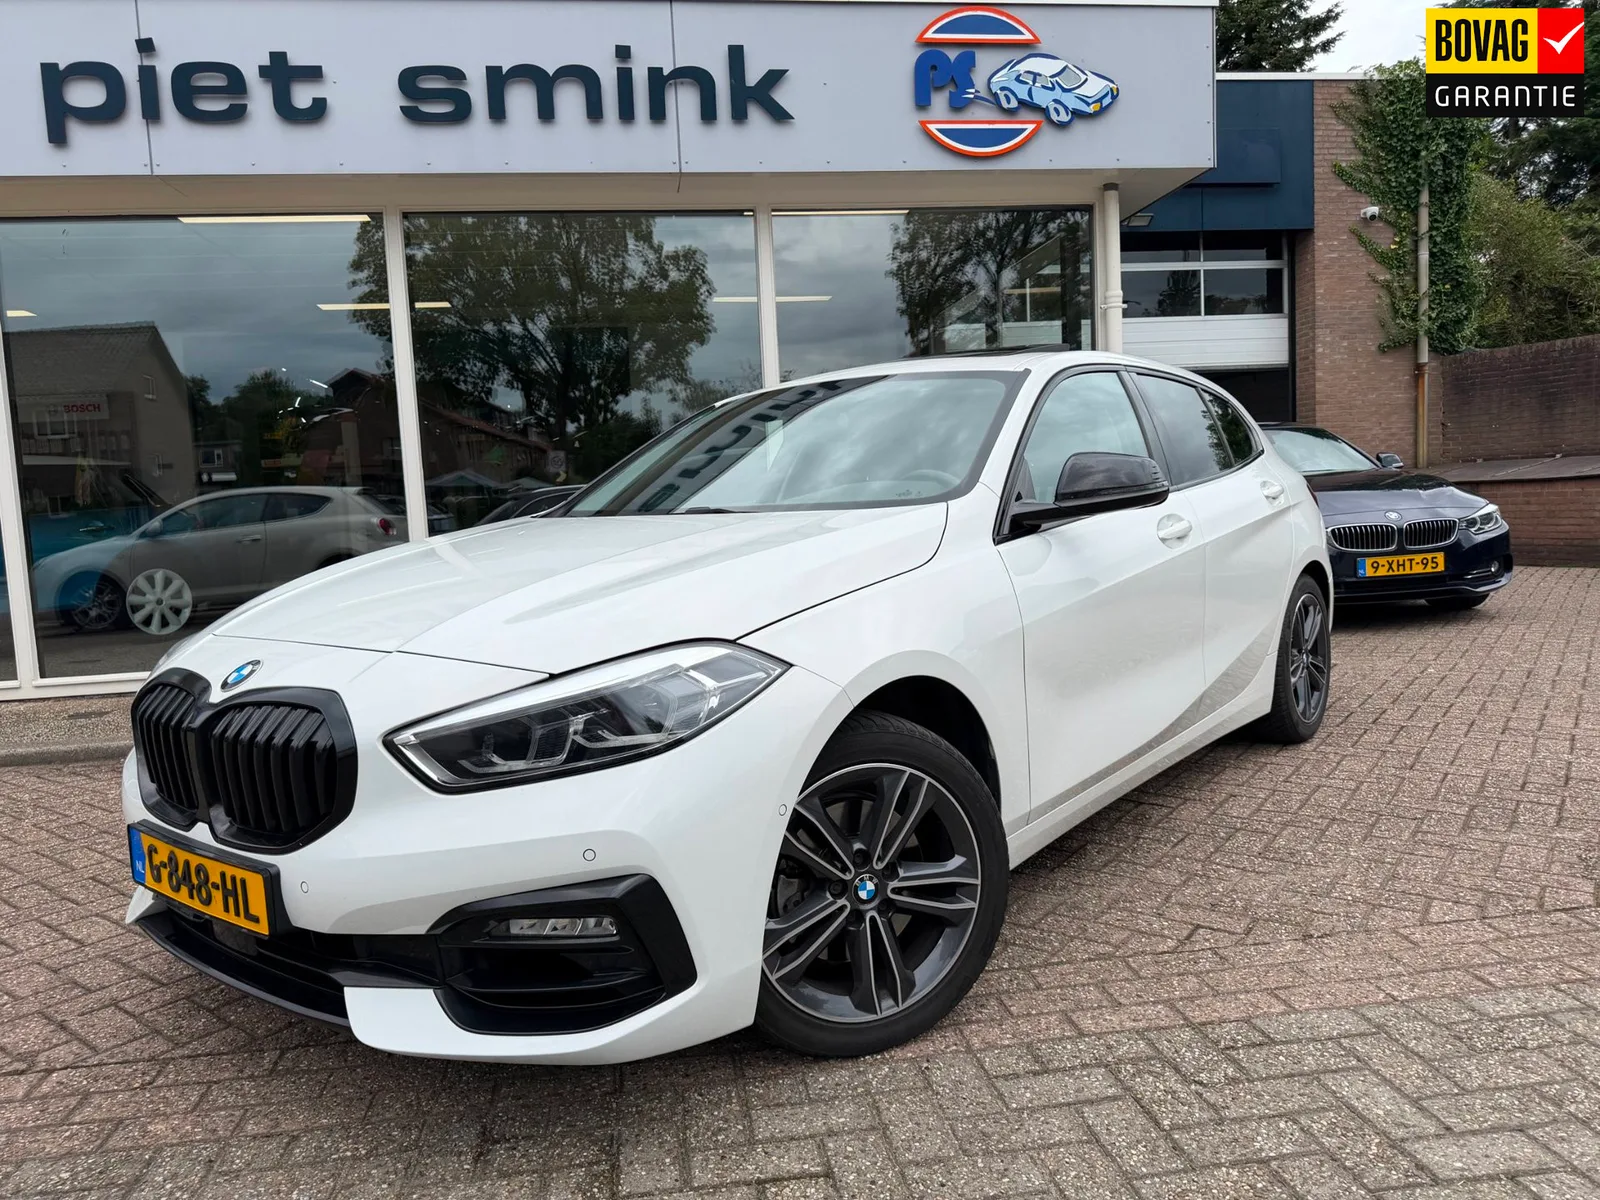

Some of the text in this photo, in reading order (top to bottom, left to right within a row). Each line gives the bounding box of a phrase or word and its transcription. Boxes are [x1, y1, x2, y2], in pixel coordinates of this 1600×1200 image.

[40, 37, 795, 145] piet smink
[63, 403, 101, 413] BOSCH
[1370, 556, 1439, 574] 9-XHT-95
[135, 859, 145, 874] NL
[147, 843, 260, 924] G-848-HL
